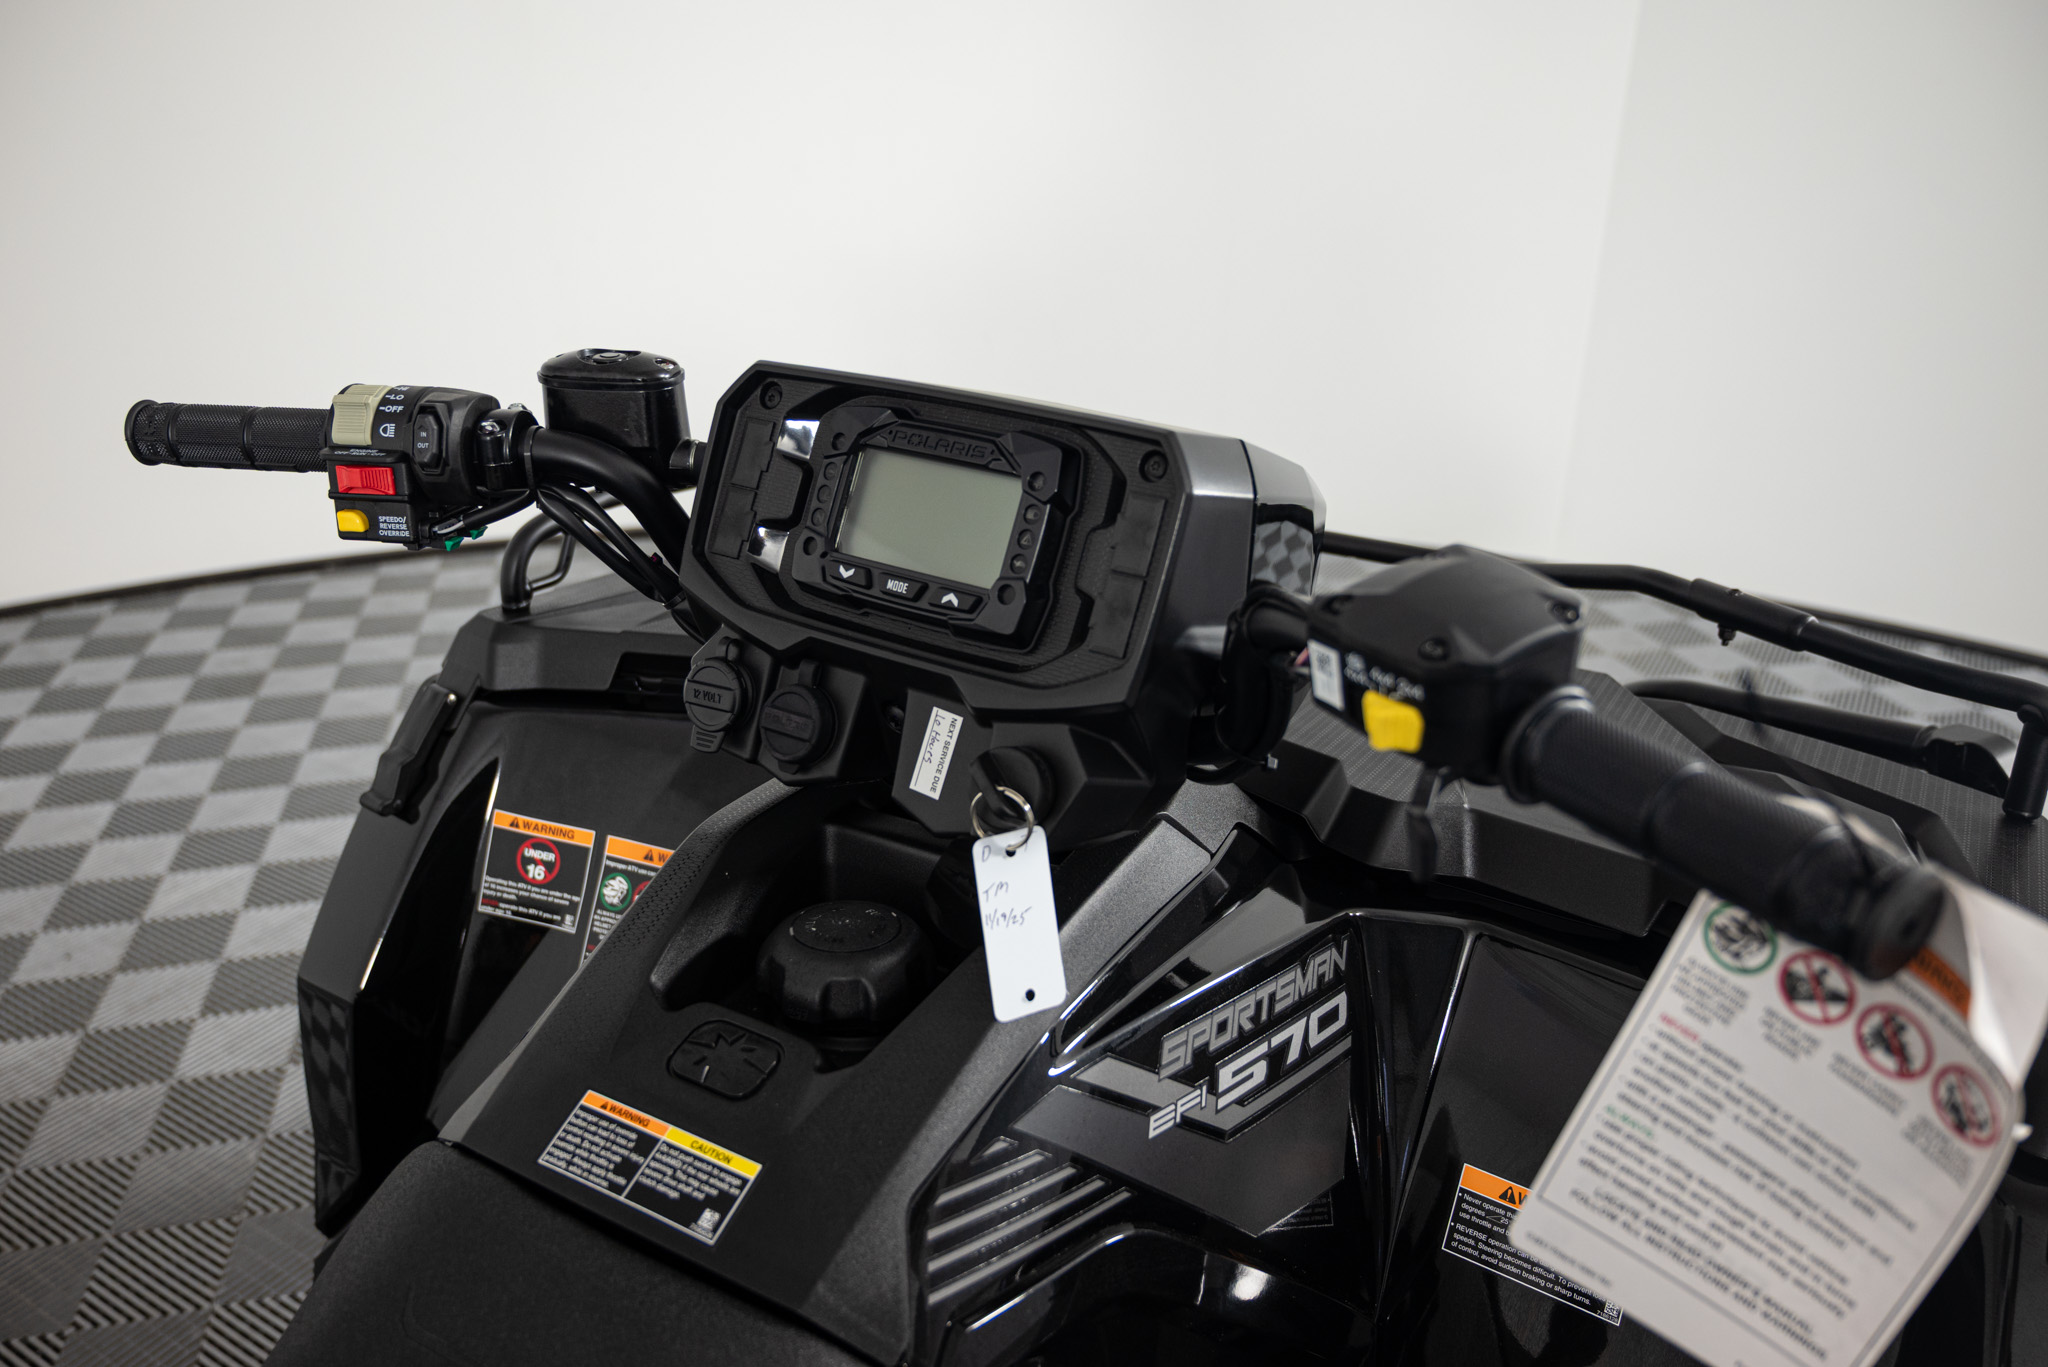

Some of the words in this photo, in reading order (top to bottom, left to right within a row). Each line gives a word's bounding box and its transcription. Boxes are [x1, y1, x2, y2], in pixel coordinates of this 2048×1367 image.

[892, 430, 988, 458] POLARIS
[886, 578, 908, 594] MODE
[694, 688, 701, 699] 12
[703, 690, 723, 704] VOLT
[947, 718, 957, 739] NEXT
[936, 741, 950, 774] SERVICE
[930, 776, 940, 793] DUE
[522, 821, 575, 840] WARNING
[524, 848, 556, 862] UNDER
[526, 864, 546, 880] 16
[1158, 938, 1348, 1080] SPORTSMAN
[1148, 1084, 1208, 1139] EFI
[1216, 990, 1348, 1110] 570
[608, 1104, 650, 1128] WARNING
[690, 1140, 733, 1164] CAUTION
[1461, 1203, 1485, 1216] degrees
[1464, 1194, 1481, 1205] Never
[1483, 1203, 1505, 1215] operate
[1471, 1216, 1491, 1228] throttle
[1493, 1226, 1505, 1234] and
[1456, 1223, 1487, 1241] REVERSE
[1488, 1238, 1517, 1253] operation
[1517, 1249, 1530, 1258] can
[1454, 1233, 1476, 1246] speeds.
[1478, 1242, 1502, 1258] Steering
[1504, 1253, 1531, 1269] becomes
[1533, 1267, 1555, 1280] difficult.
[1558, 1276, 1567, 1284] To
[1567, 1280, 1592, 1295] prevent
[1458, 1244, 1479, 1257] control,
[1481, 1254, 1498, 1264] avoid
[1499, 1262, 1521, 1274] sudden
[1522, 1271, 1545, 1286] braking
[1554, 1286, 1572, 1297] sharp
[1573, 1293, 1590, 1305] turns.
